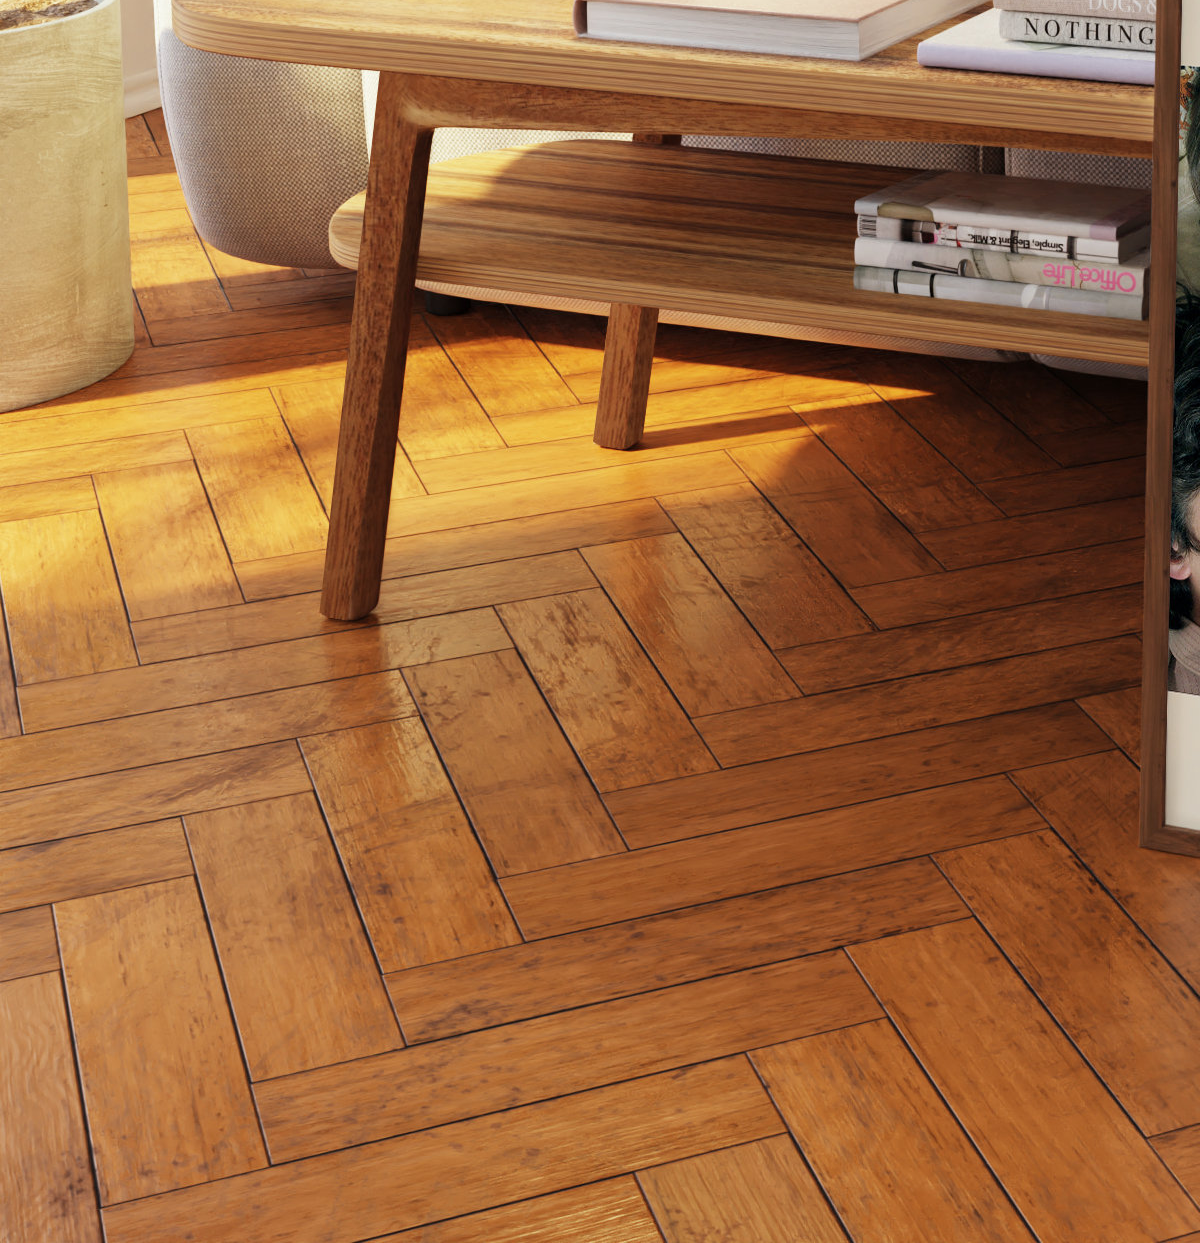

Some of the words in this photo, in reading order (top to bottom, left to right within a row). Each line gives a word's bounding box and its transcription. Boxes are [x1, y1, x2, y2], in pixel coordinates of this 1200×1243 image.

[1024, 18, 1155, 45] NOTHING
[1043, 263, 1075, 287] Life
[1080, 267, 1136, 292] Office
